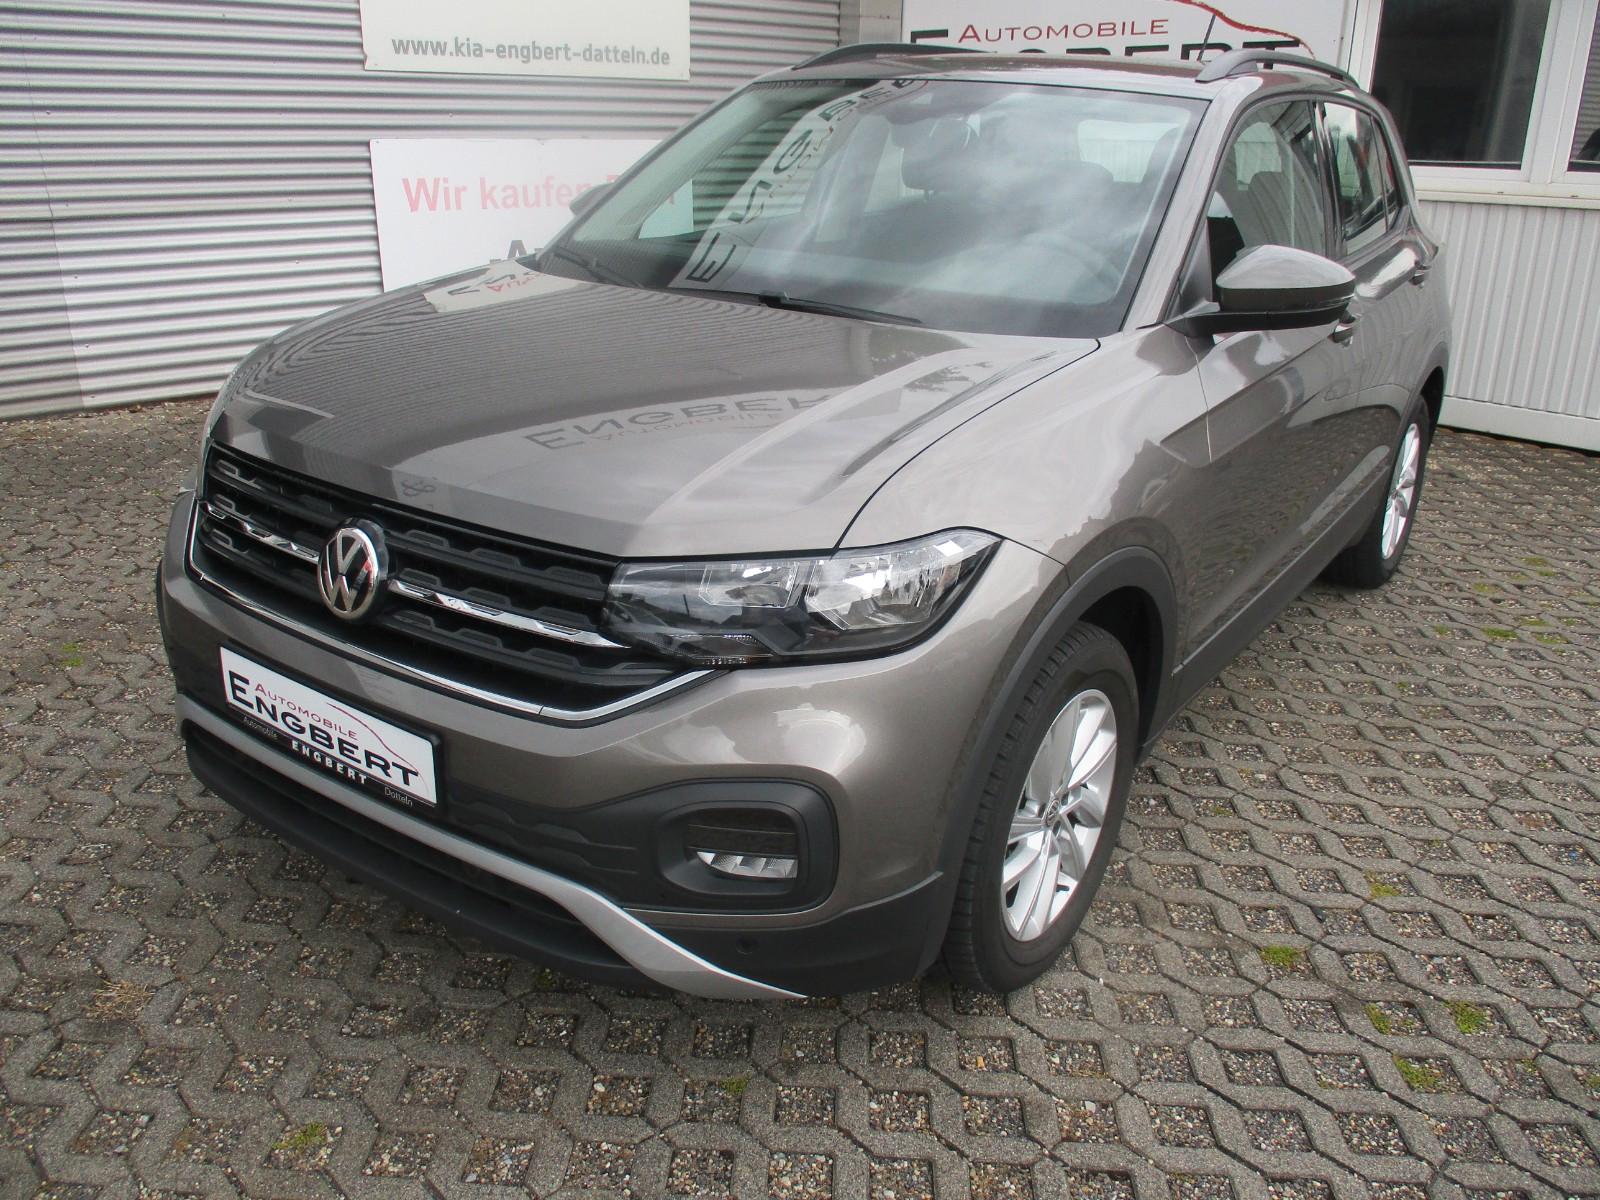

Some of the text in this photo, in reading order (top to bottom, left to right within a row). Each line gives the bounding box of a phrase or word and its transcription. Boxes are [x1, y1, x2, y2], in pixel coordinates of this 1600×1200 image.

[391, 36, 671, 66] www.kia-engbert-datteln.de
[957, 18, 1170, 44] AUTOMOBILE
[401, 177, 468, 213] Wir
[228, 669, 420, 787] ENGBERT
[254, 683, 358, 741] AUTOMOBILE
[291, 740, 368, 785] ENGBERT
